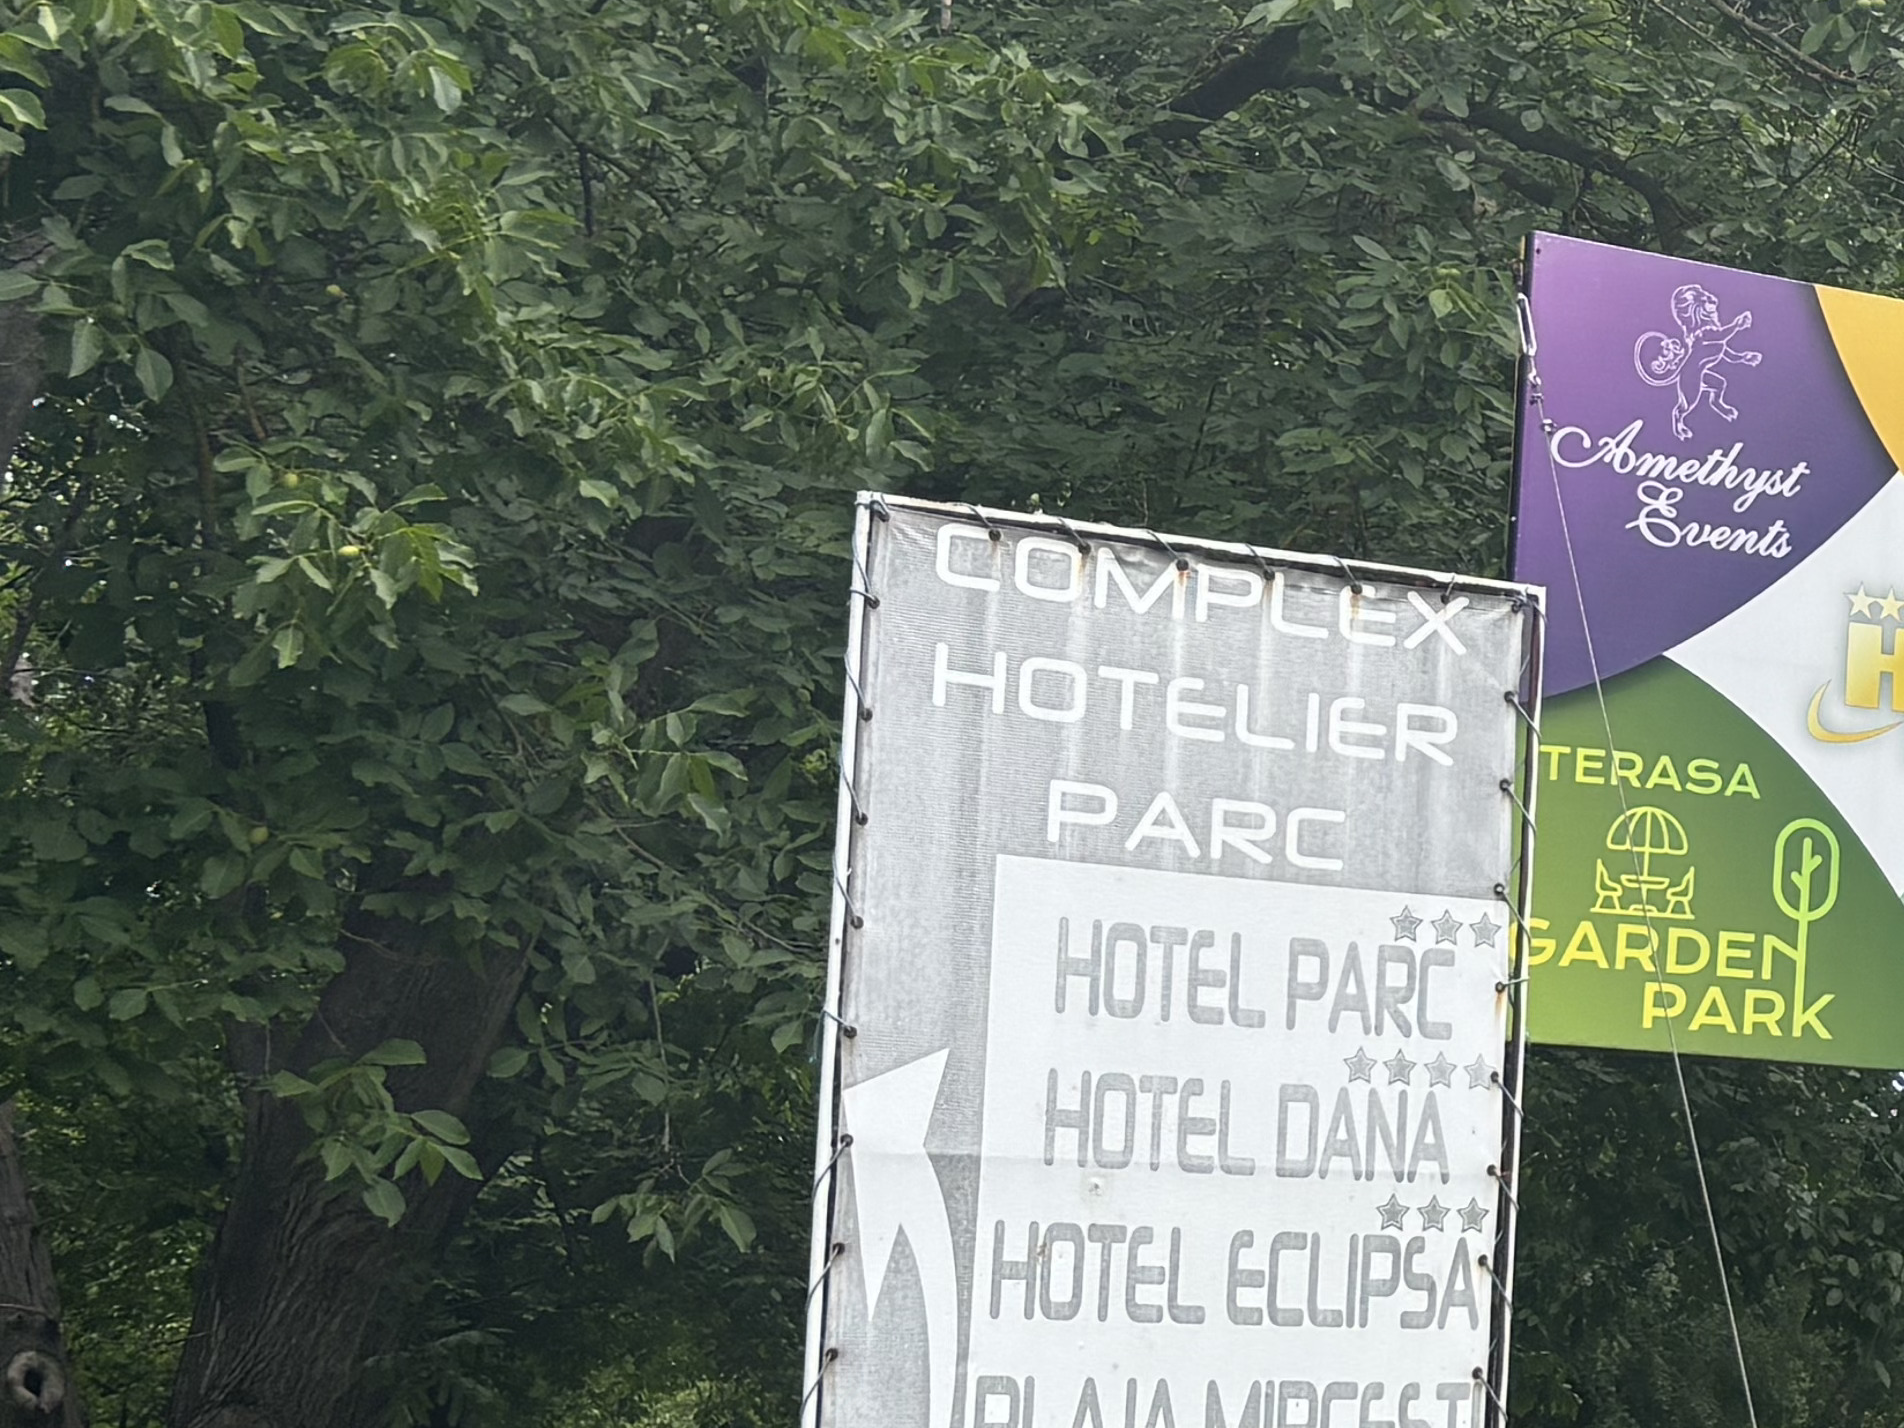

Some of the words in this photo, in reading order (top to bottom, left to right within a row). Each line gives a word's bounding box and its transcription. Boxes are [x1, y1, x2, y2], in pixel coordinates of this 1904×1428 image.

[1550, 419, 1811, 513] Amethyst
[1625, 481, 1792, 558] Events
[935, 522, 1470, 655] COMPLEX
[932, 642, 1459, 766] HOTELIER
[1539, 744, 1761, 799] TERASA
[1047, 779, 1347, 872] PARC
[1055, 916, 1266, 1028] HOTEL
[1285, 937, 1455, 1041] PARC
[1509, 917, 1807, 981] GARDEN
[1642, 981, 1836, 1040] PARK
[1043, 1067, 1257, 1177] HOTEL
[1276, 1082, 1450, 1184] DANA
[989, 1220, 1206, 1325] HOTEL
[1226, 1229, 1480, 1330] ECLIPSA
